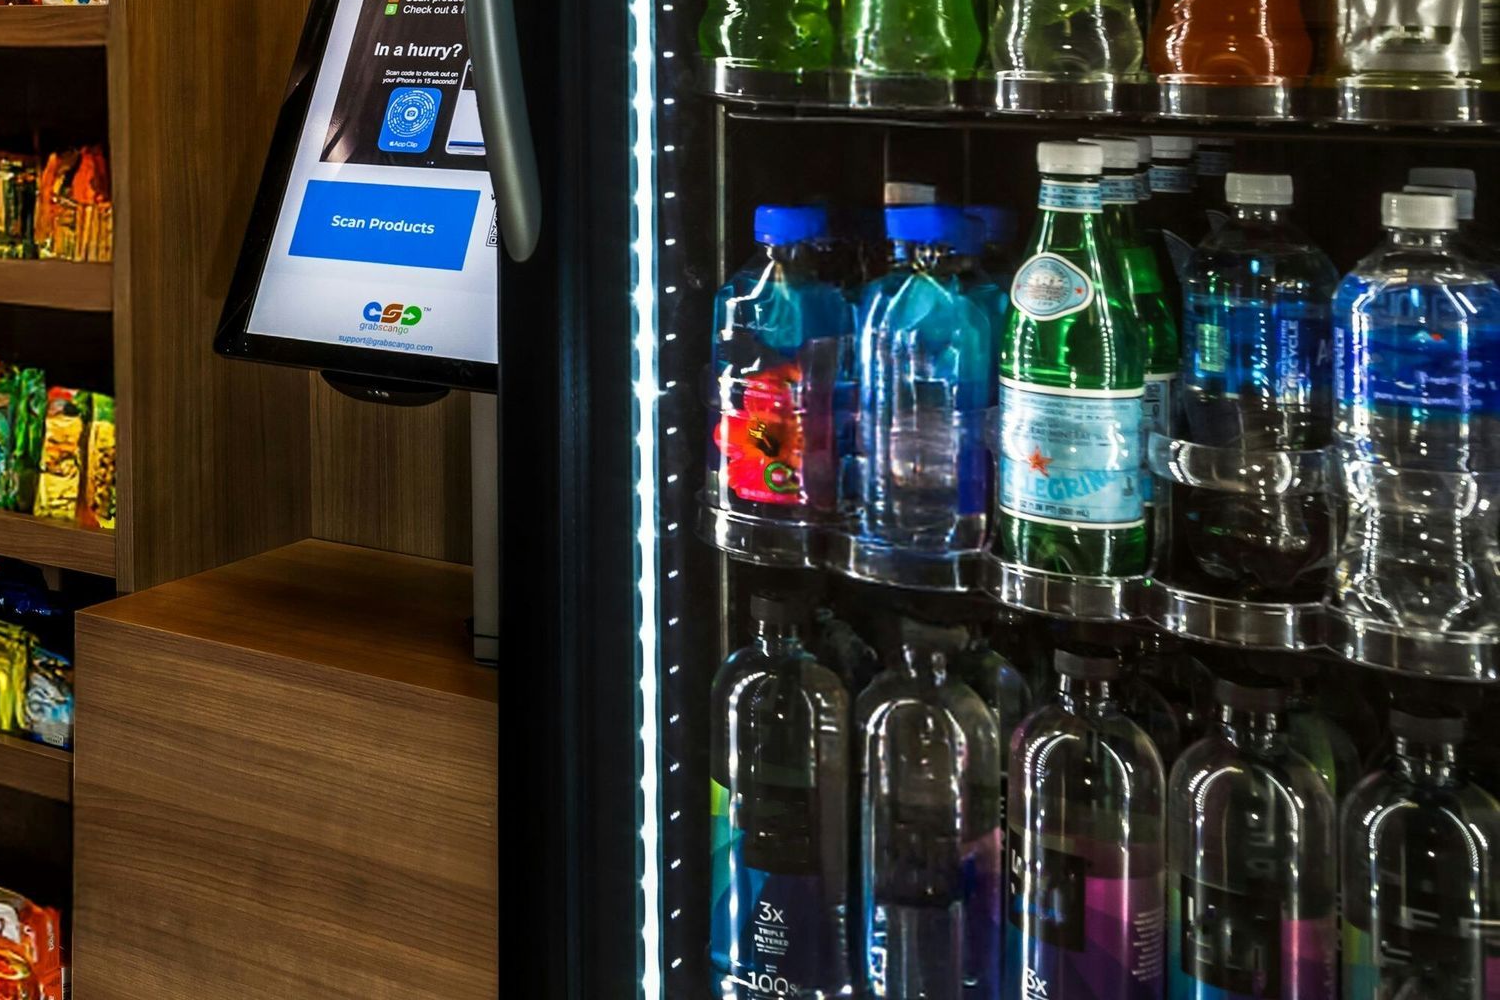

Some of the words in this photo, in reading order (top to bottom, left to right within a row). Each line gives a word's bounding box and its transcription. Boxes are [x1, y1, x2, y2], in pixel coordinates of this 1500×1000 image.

[403, 5, 432, 14] Check
[438, 5, 449, 14] out
[451, 5, 458, 14] &
[374, 42, 390, 57] In
[393, 46, 403, 57] a
[407, 43, 463, 61] hurry?
[331, 214, 366, 229] Scan
[369, 218, 435, 235] Products
[359, 321, 409, 335] grabscango
[338, 335, 434, 352] support@grabscango.com
[759, 901, 784, 924] 3x
[754, 934, 789, 946] FILTERED
[758, 927, 785, 938] TRIPLE
